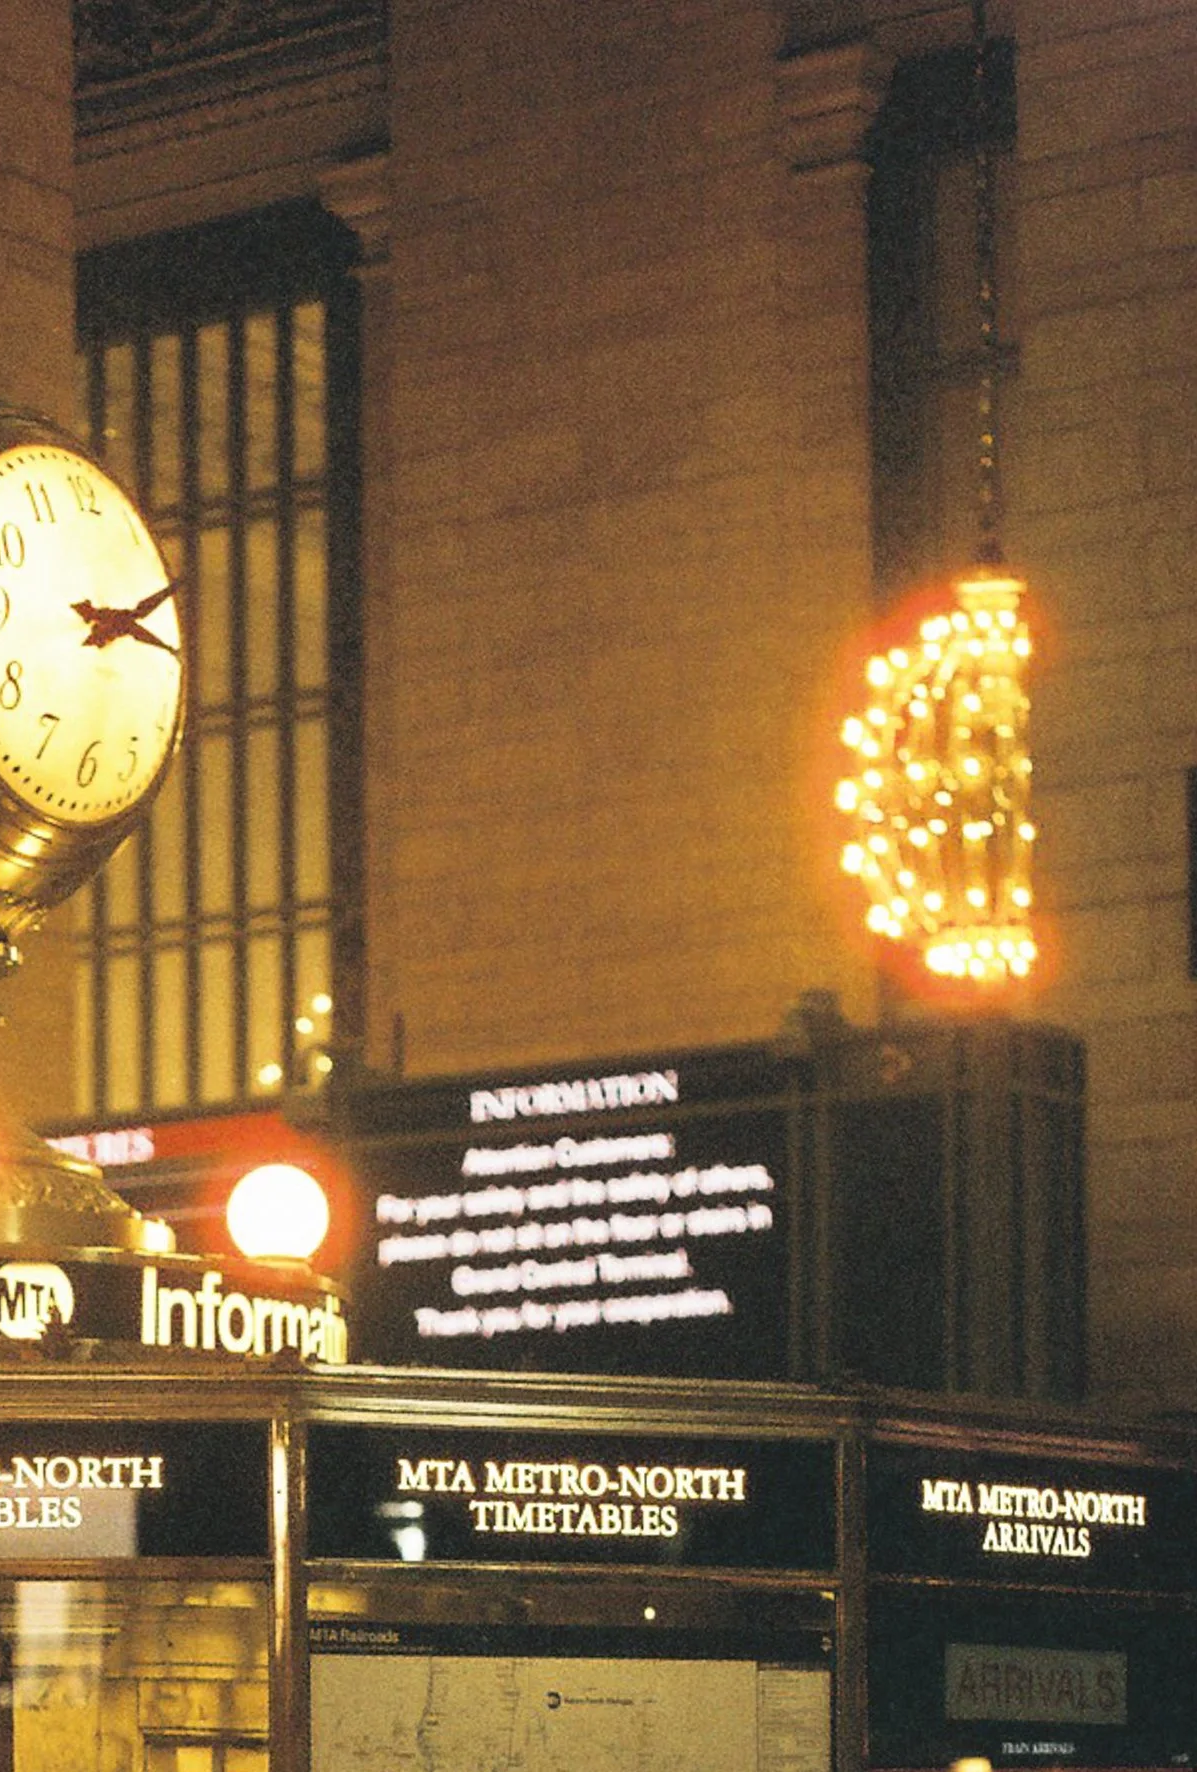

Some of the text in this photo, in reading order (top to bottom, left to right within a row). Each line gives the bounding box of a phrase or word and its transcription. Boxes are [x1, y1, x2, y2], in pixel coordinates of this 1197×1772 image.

[24, 480, 56, 524] 11
[67, 474, 102, 515] 12
[34, 712, 61, 761] 7
[76, 739, 102, 788] 6
[398, 1459, 745, 1501] MTA METRO-NORTH
[469, 1500, 678, 1537] TIMETABLES
[922, 1480, 1145, 1526] MTA METRO-NORTH
[982, 1520, 1091, 1558] ARRIVALS
[957, 1661, 1118, 1713] ARRIVALS
